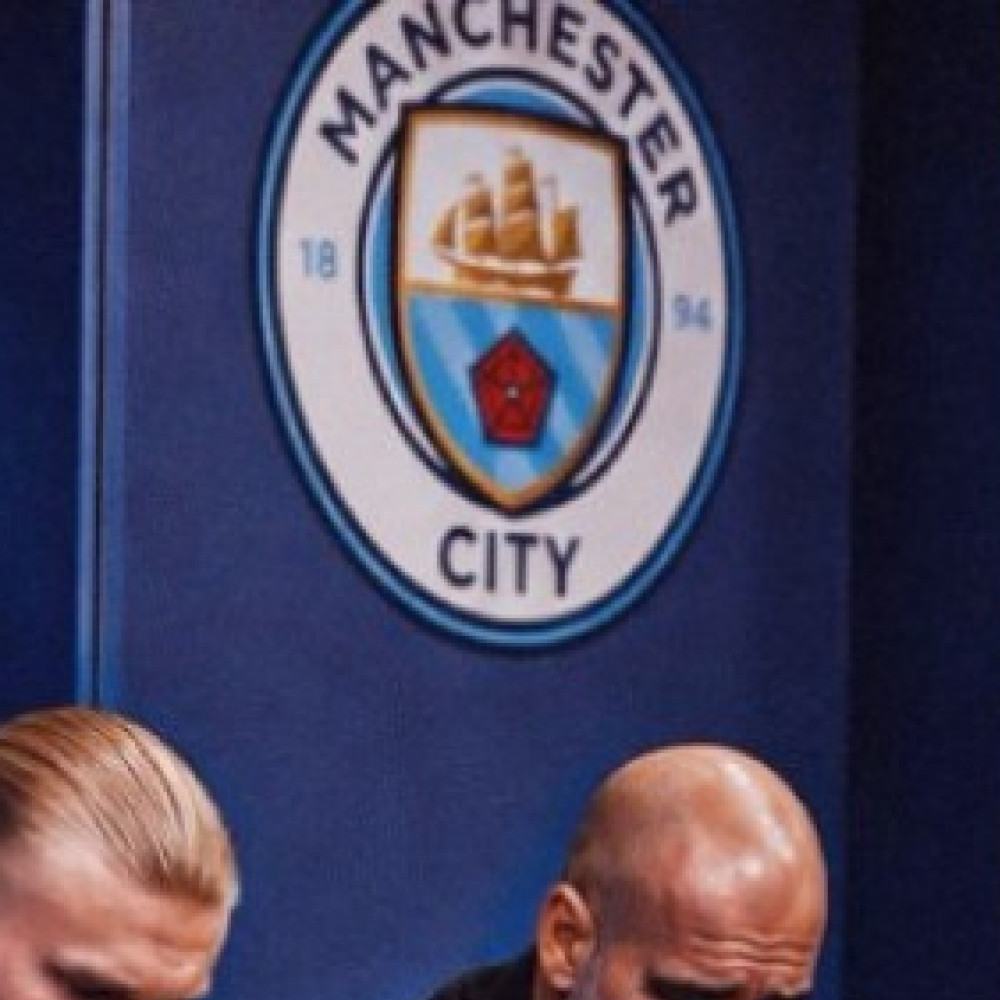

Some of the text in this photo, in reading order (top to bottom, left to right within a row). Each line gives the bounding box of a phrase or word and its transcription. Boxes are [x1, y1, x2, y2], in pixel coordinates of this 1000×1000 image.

[318, 0, 698, 226] MANCHESTER
[300, 238, 338, 281] 18
[671, 295, 712, 333] 94
[438, 526, 581, 597] CITY
